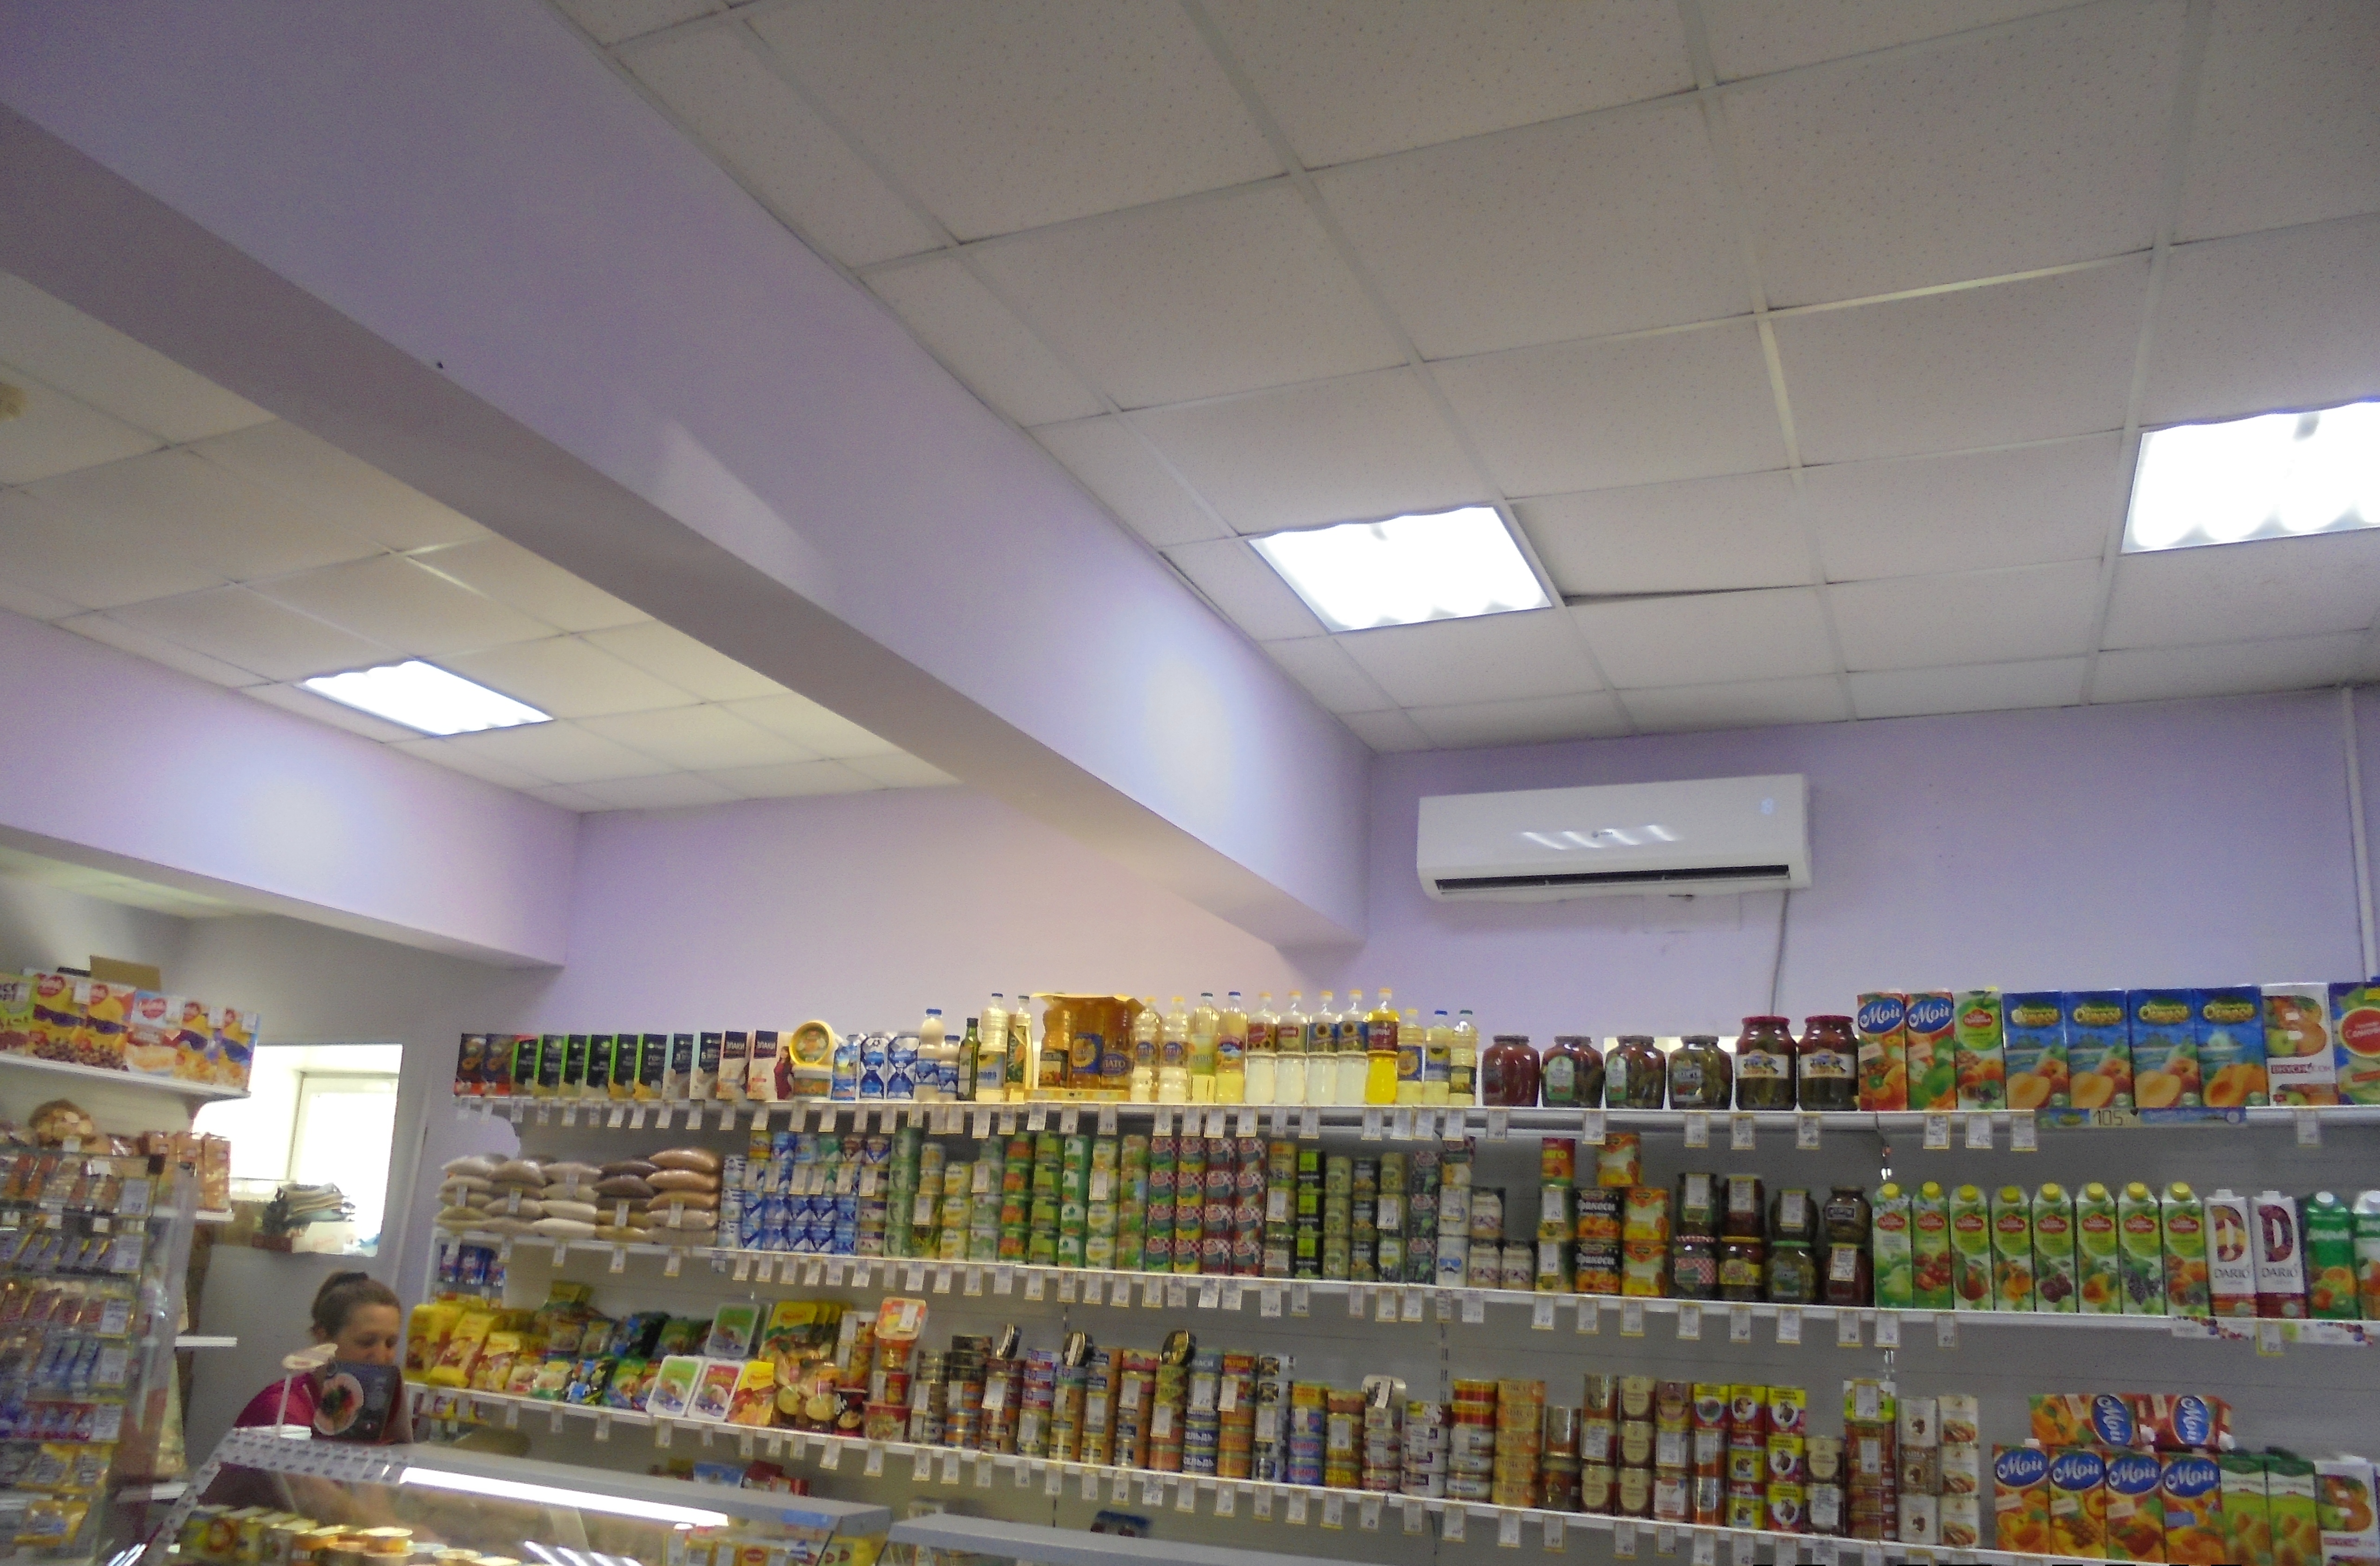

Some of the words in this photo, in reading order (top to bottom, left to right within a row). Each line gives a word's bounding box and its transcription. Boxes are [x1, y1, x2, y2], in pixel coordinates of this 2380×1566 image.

[2094, 1110, 2123, 1126] 105
[2210, 1206, 2246, 1262] D
[2258, 1205, 2293, 1263] D
